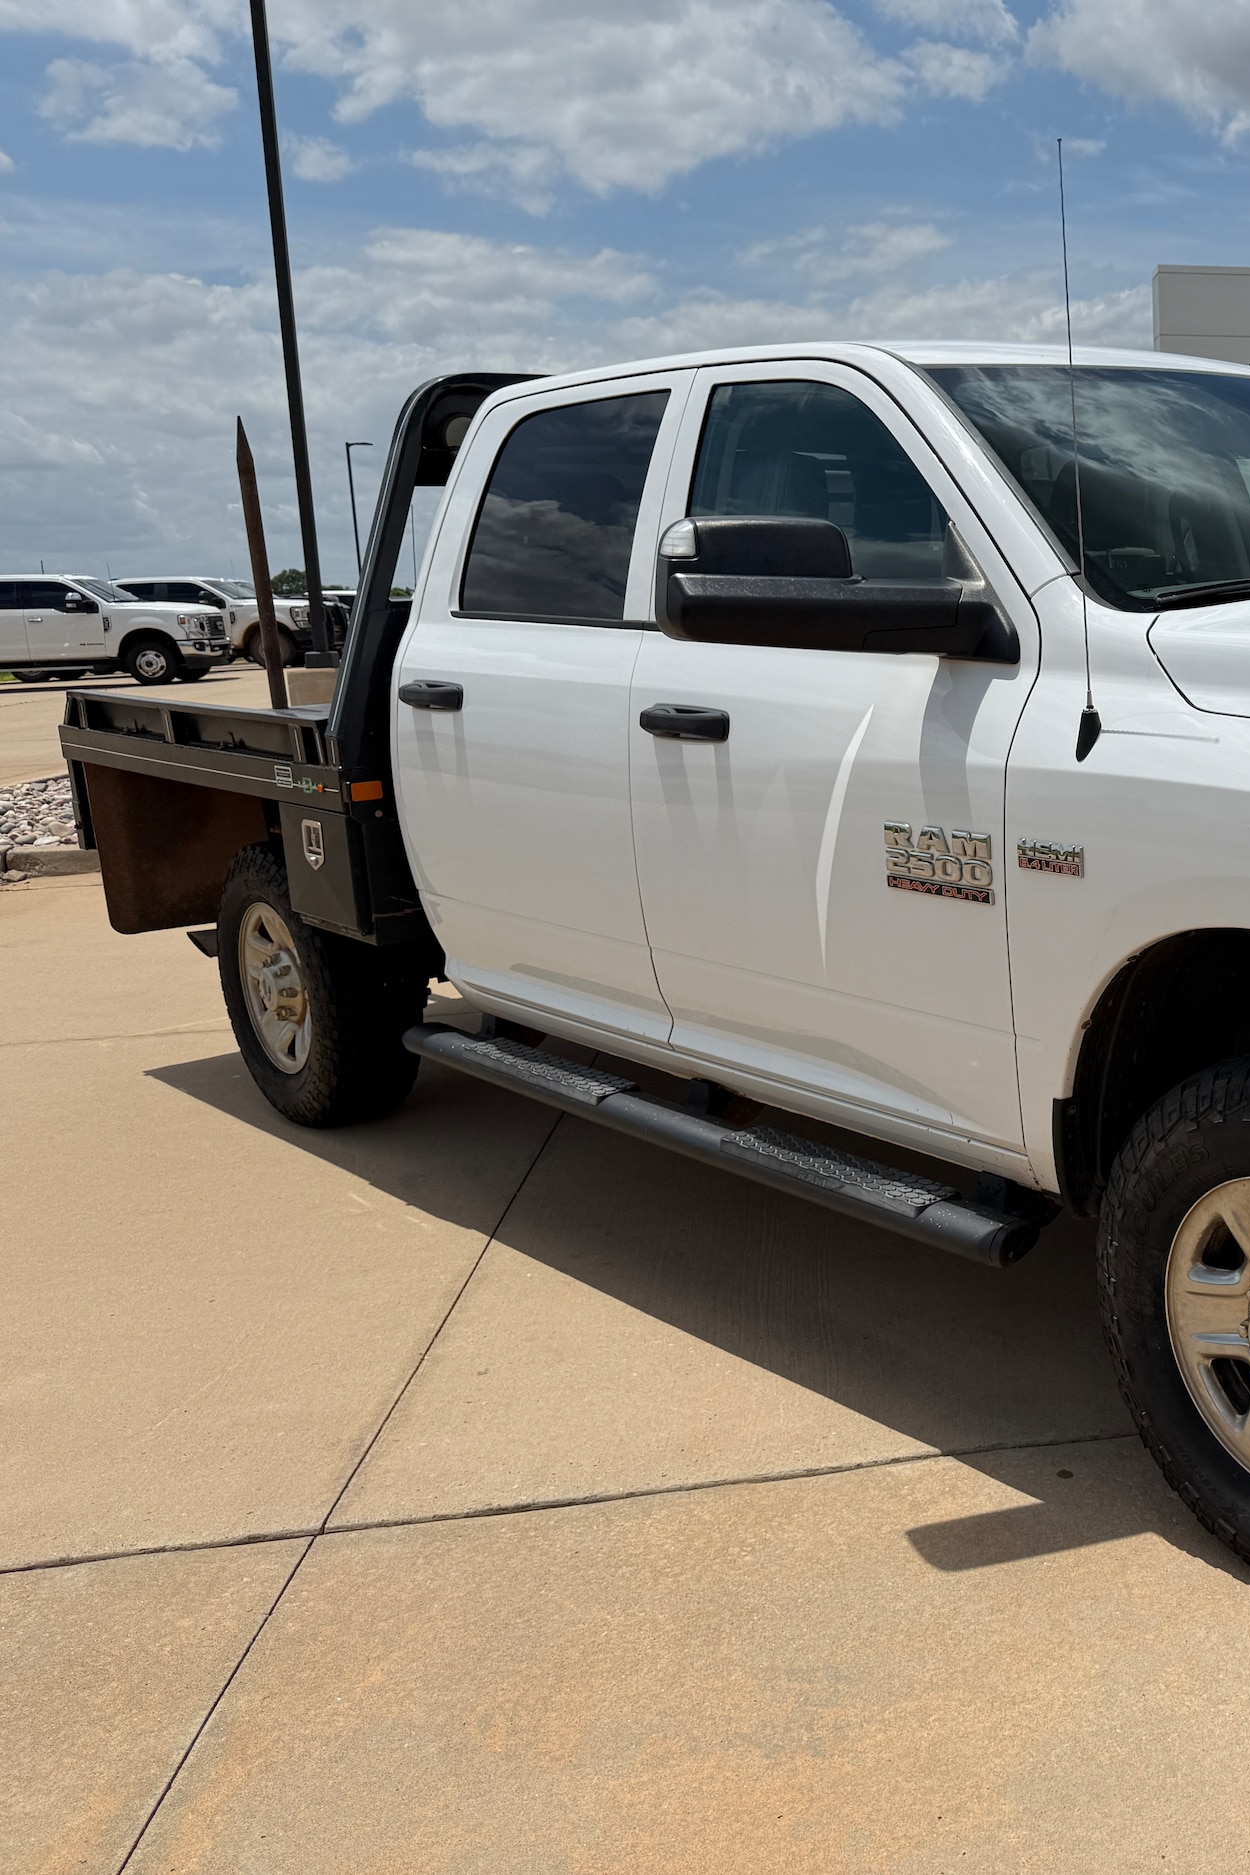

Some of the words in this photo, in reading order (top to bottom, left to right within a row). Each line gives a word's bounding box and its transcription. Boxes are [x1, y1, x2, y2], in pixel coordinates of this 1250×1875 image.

[884, 820, 992, 860] RAM
[1017, 838, 1084, 863] HEMI
[886, 847, 993, 887] 2500
[1019, 857, 1041, 870] 6.4
[1042, 859, 1080, 877] LITER
[889, 877, 941, 895] HEAVY
[941, 887, 988, 902] DUTY
